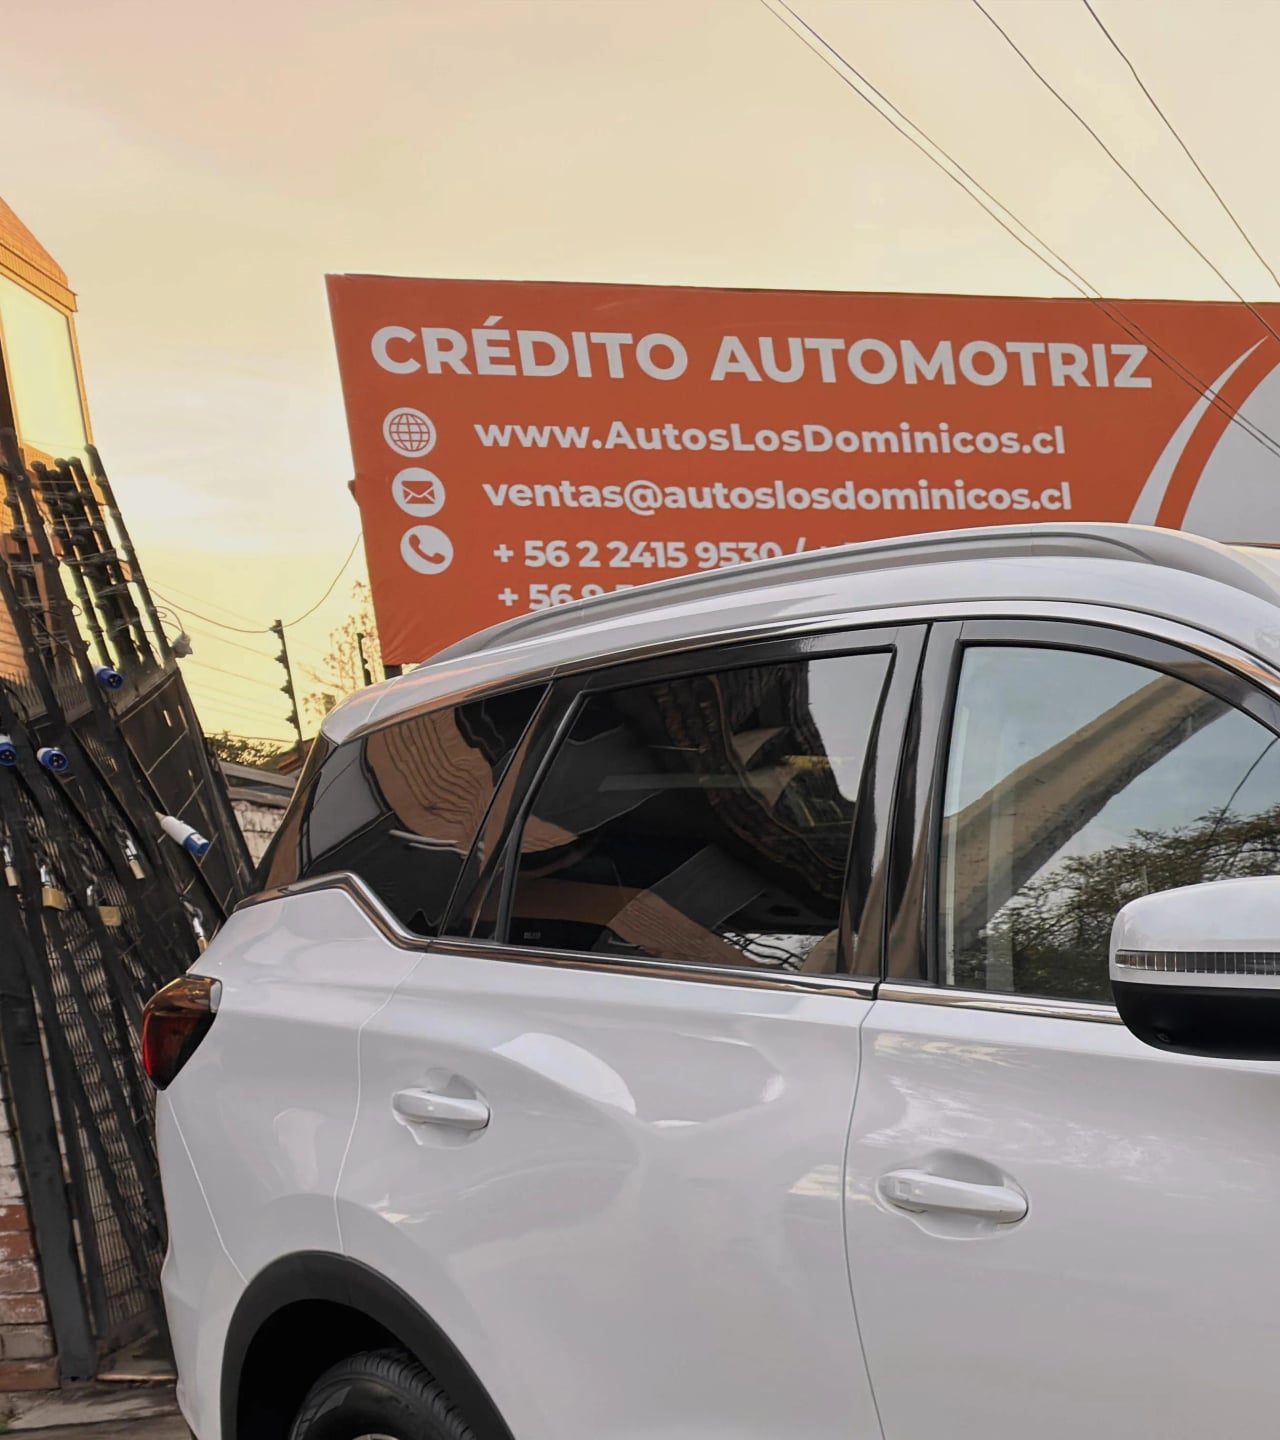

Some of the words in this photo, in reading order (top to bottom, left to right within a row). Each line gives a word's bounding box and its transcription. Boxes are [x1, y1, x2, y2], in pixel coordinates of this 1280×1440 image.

[370, 315, 689, 381] CRÉDITO
[710, 335, 1153, 389] AUTOMOTRIZ
[473, 420, 1066, 455] www.AutosLosDominicos.cl
[481, 478, 1072, 517] ventas@autoslosdominicos.cl
[524, 539, 570, 568] 56
[575, 540, 602, 568] 2
[606, 540, 689, 569] 2415
